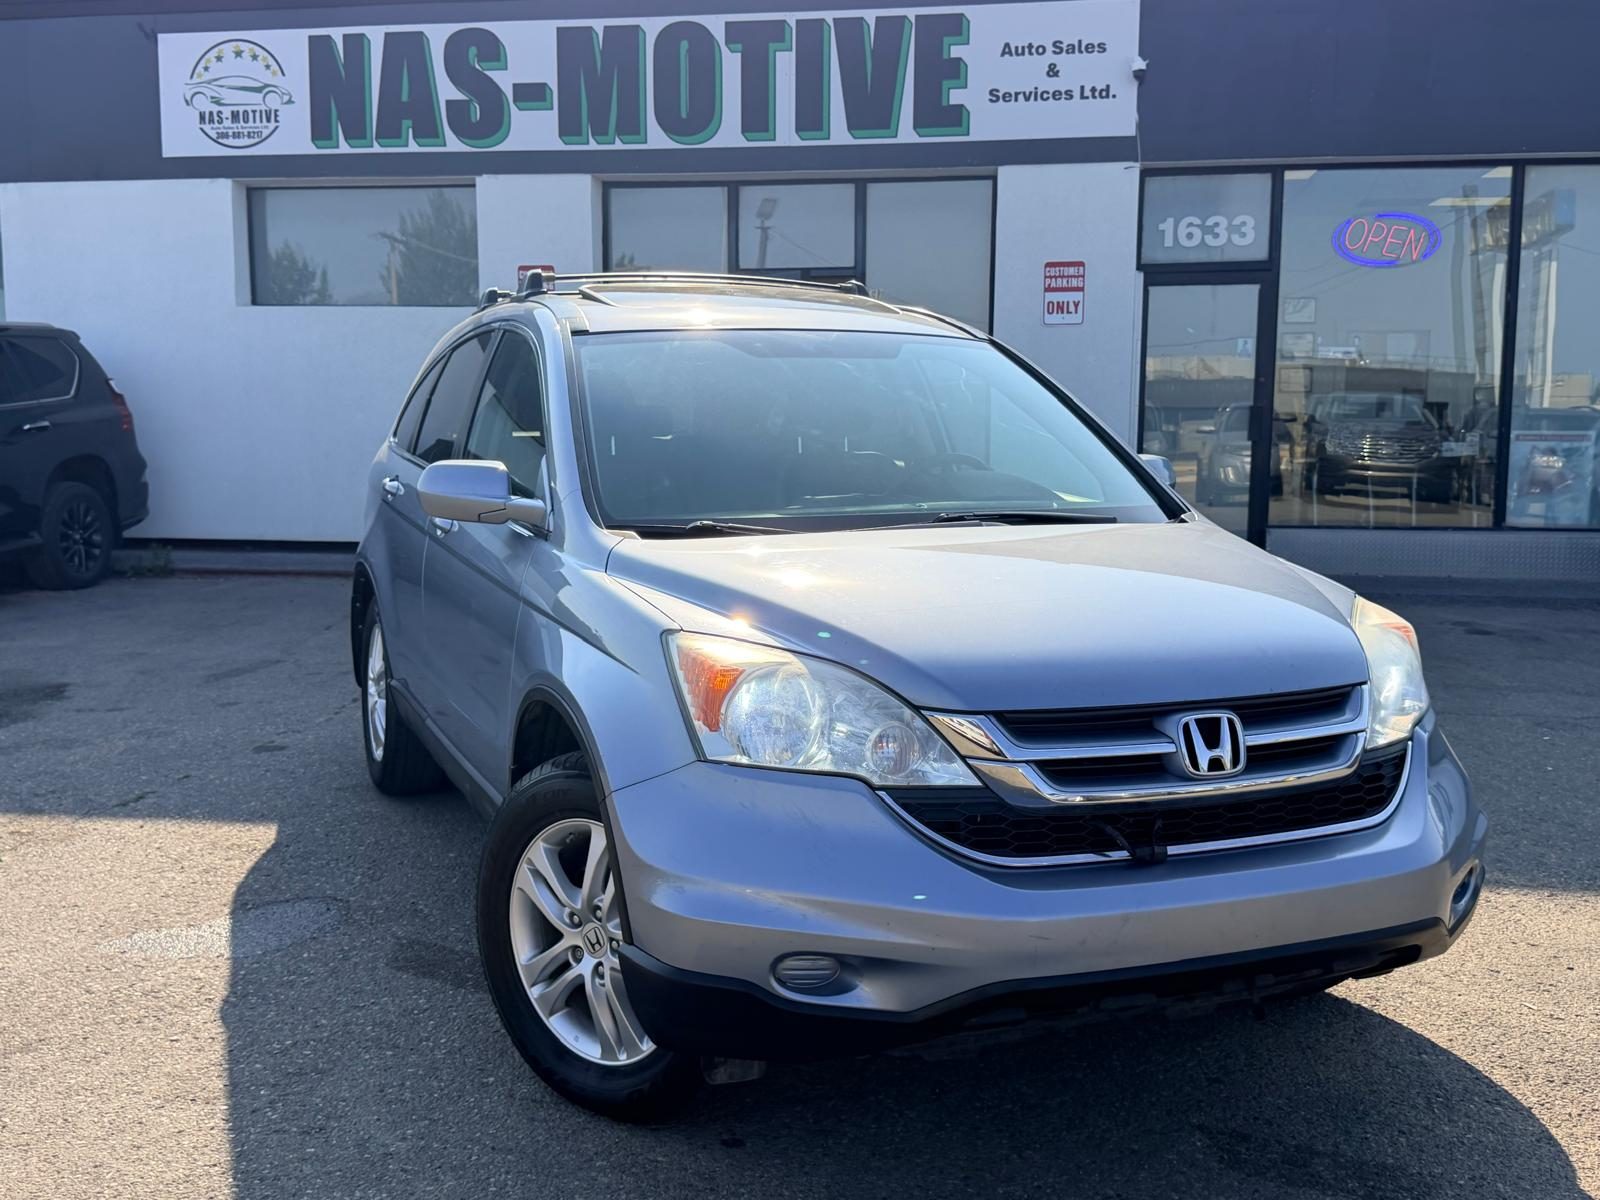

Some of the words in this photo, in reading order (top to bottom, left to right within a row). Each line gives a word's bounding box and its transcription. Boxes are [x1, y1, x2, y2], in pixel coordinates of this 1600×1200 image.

[1000, 42, 1047, 58] Auto
[1051, 39, 1107, 55] Sales
[1045, 62, 1060, 78] &
[308, 13, 970, 149] NAS-MOTIVE
[988, 86, 1074, 103] Services
[1079, 84, 1117, 100] Ltd.
[199, 109, 280, 125] NAS-MOTIVE
[1158, 215, 1256, 248] 1633
[1345, 217, 1425, 262] OPEN
[1045, 266, 1084, 277] CUSTOMER
[1045, 277, 1084, 288] PARKING
[1046, 300, 1080, 315] ONLY
